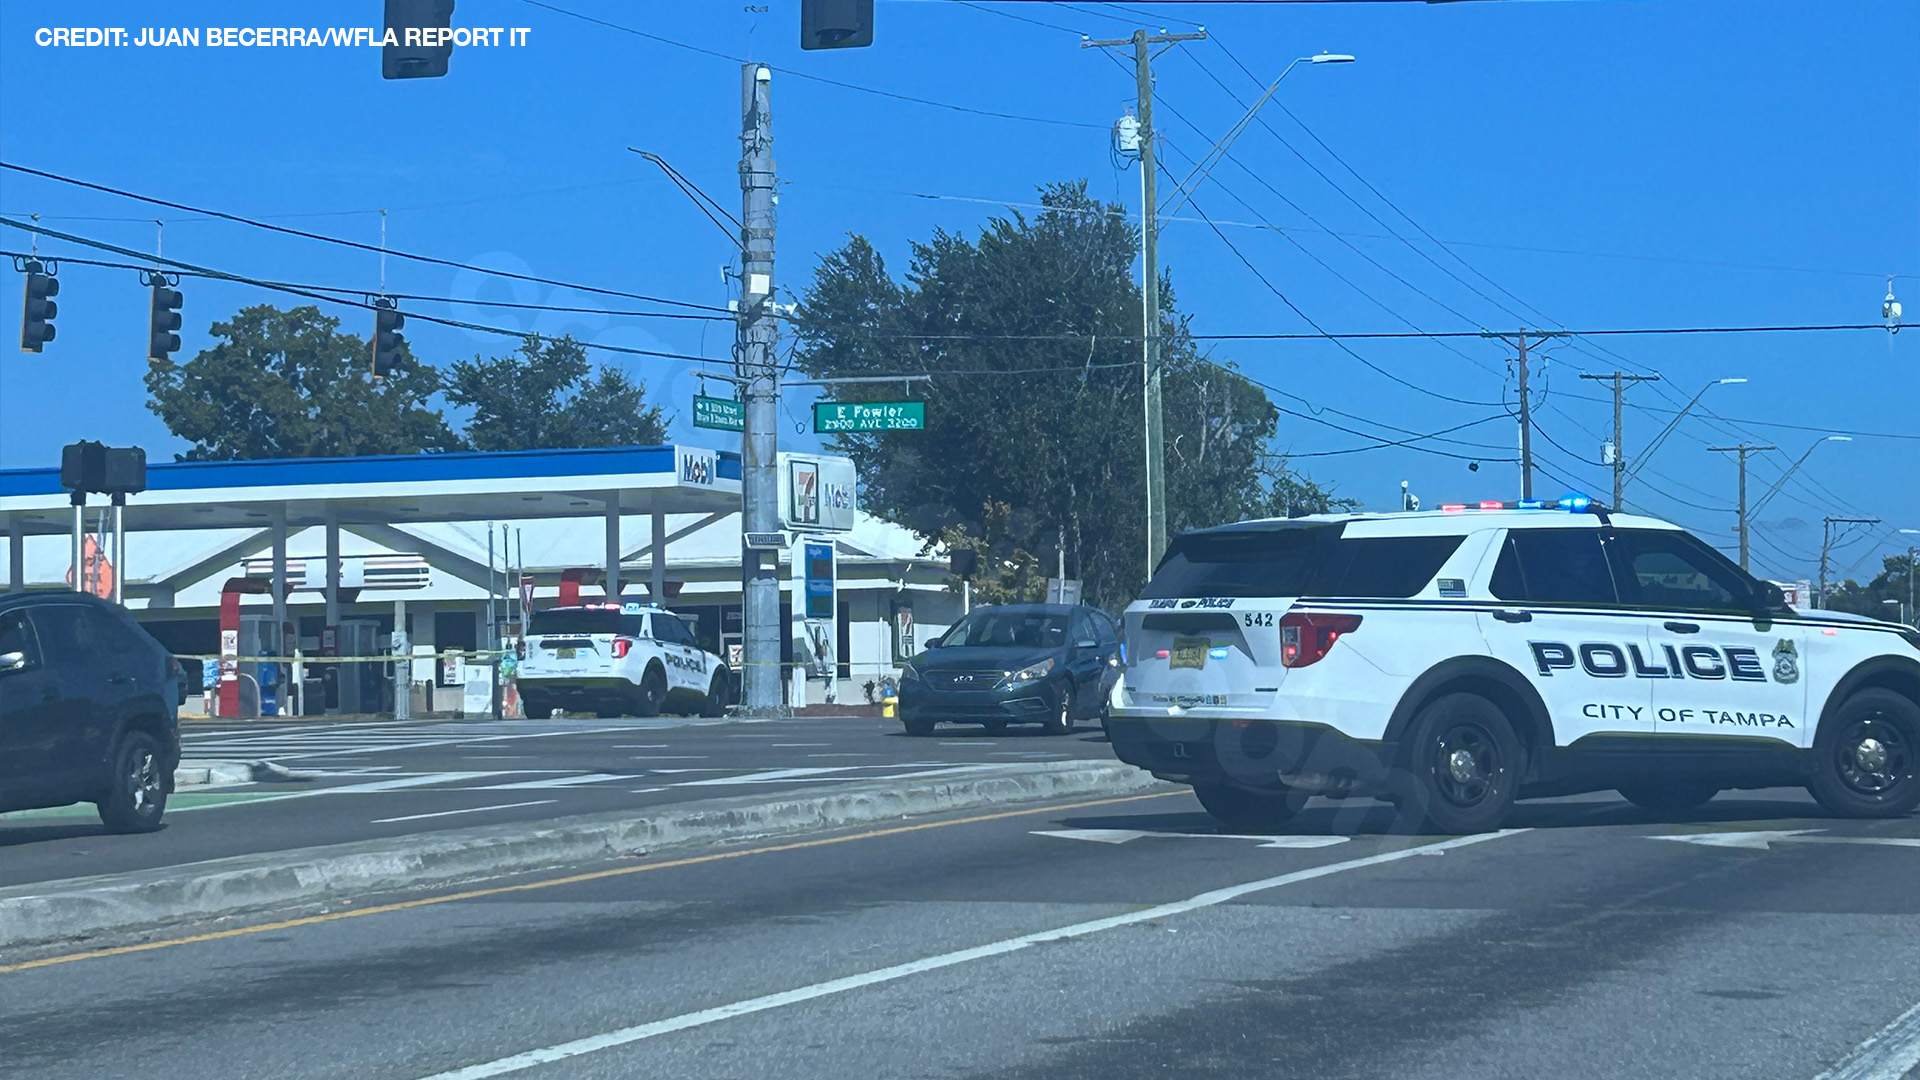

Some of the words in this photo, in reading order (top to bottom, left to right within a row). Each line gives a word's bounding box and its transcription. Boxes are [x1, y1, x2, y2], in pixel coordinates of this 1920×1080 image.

[837, 406, 846, 419] E
[854, 405, 903, 419] Fowler
[860, 418, 882, 429] AVE
[1244, 612, 1274, 627] 542
[1527, 640, 1767, 683] POLICE
[1582, 703, 1644, 721] CITY
[1657, 708, 1695, 723] OF
[1702, 710, 1796, 729] TAMPA
